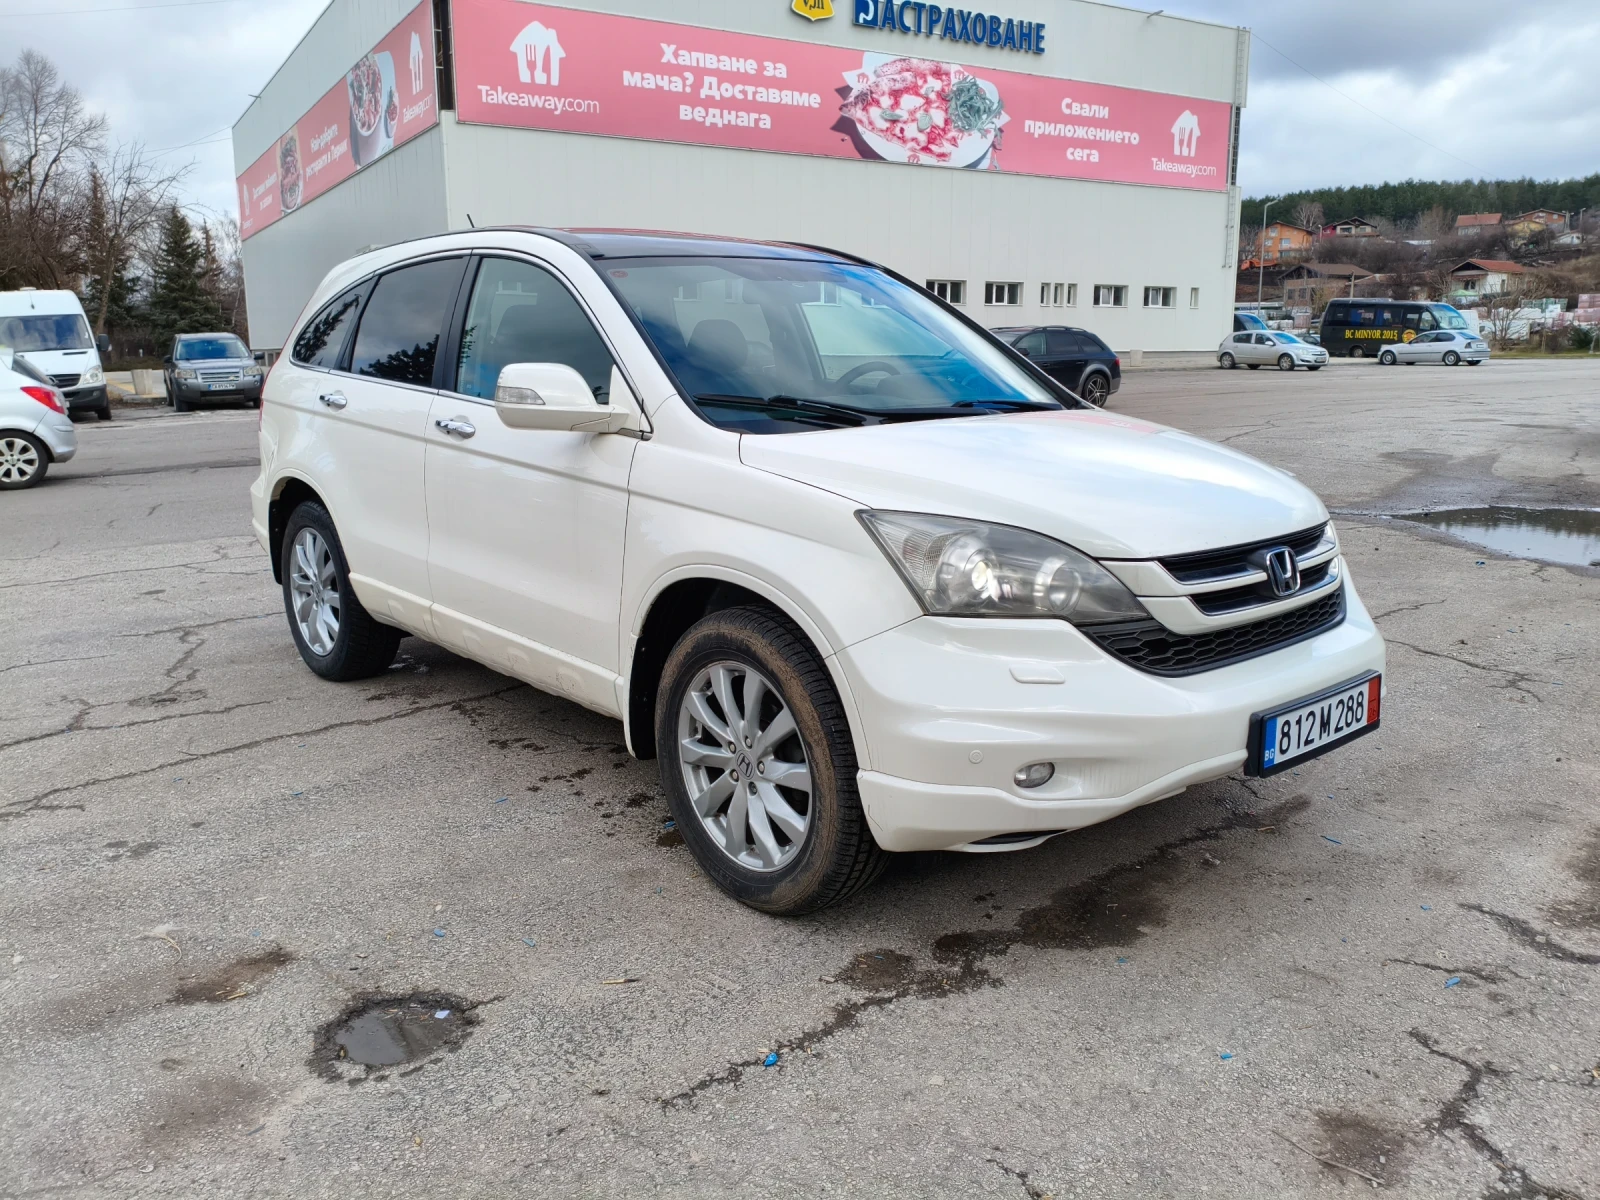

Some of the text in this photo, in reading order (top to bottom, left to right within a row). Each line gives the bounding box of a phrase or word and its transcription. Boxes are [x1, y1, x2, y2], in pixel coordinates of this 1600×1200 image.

[660, 43, 788, 78] Хапване за
[477, 85, 600, 115] Takeaway.com
[623, 70, 821, 108] мача? Доставяме
[679, 105, 771, 129] веднага
[1061, 97, 1109, 119] Свали
[1024, 119, 1140, 145] приложението
[1066, 147, 1099, 163] сега
[1151, 157, 1217, 178] Takeaway.com
[1345, 329, 1355, 339] BC
[1354, 329, 1381, 339] MINYOR
[1264, 748, 1275, 762] BG
